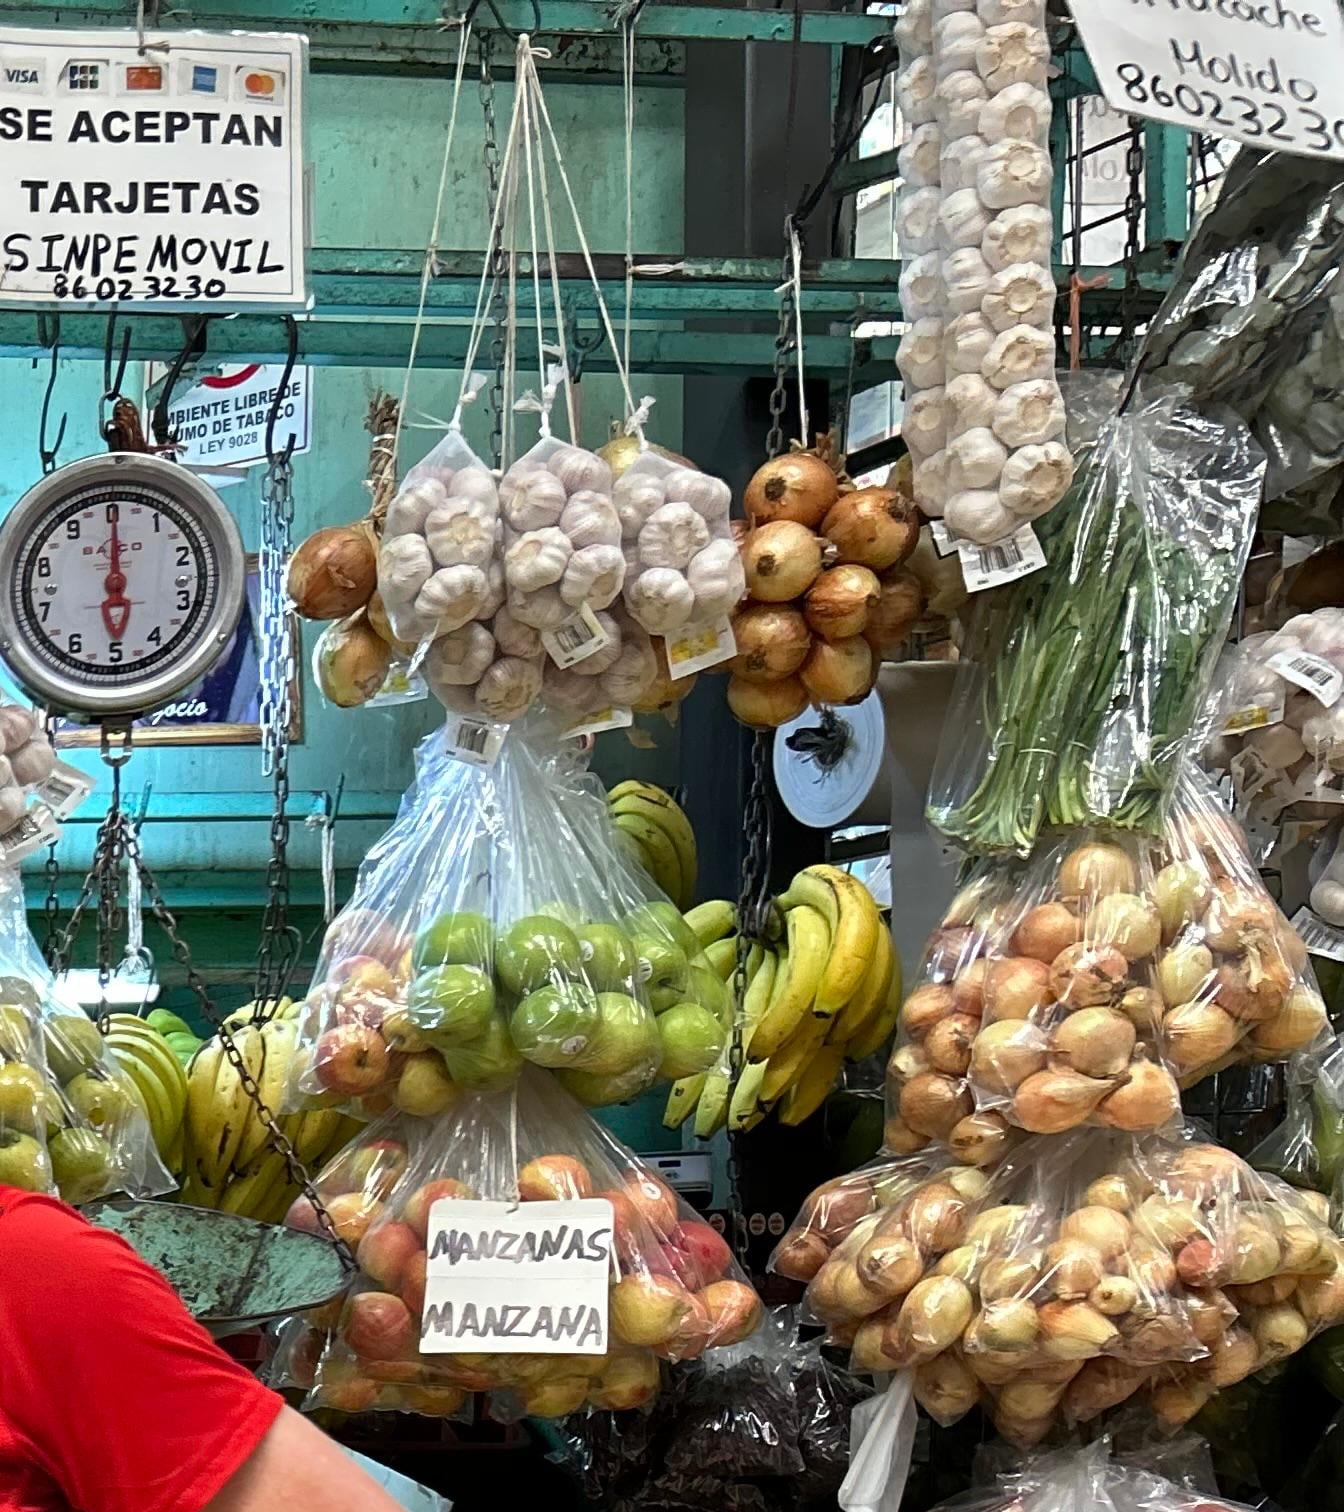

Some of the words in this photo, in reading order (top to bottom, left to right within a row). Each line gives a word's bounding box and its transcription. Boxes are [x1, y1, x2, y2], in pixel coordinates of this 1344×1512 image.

[4, 68, 39, 84] VISA
[1169, 38, 1318, 102] Molido
[67, 110, 283, 147] ACEPTAN
[20, 180, 261, 216] TARJETAS
[2, 233, 140, 277] SINPE
[146, 234, 285, 275] MOVIL
[167, 400, 230, 426] MBIENTE
[234, 387, 278, 411] LIBRE
[175, 423, 208, 443] UMO
[212, 418, 232, 435] DE
[199, 438, 226, 455] LEY
[228, 431, 258, 449] 9028
[66, 519, 81, 539] 9
[151, 512, 161, 533] 1
[38, 557, 51, 577] 8
[175, 546, 190, 567] 2
[176, 590, 191, 611] 3
[39, 602, 51, 622] 7
[68, 633, 83, 654] 6
[147, 626, 161, 647] 4
[109, 642, 123, 663] 5
[429, 1225, 611, 1266] MANZANAS
[421, 1301, 603, 1347] MANZANA
